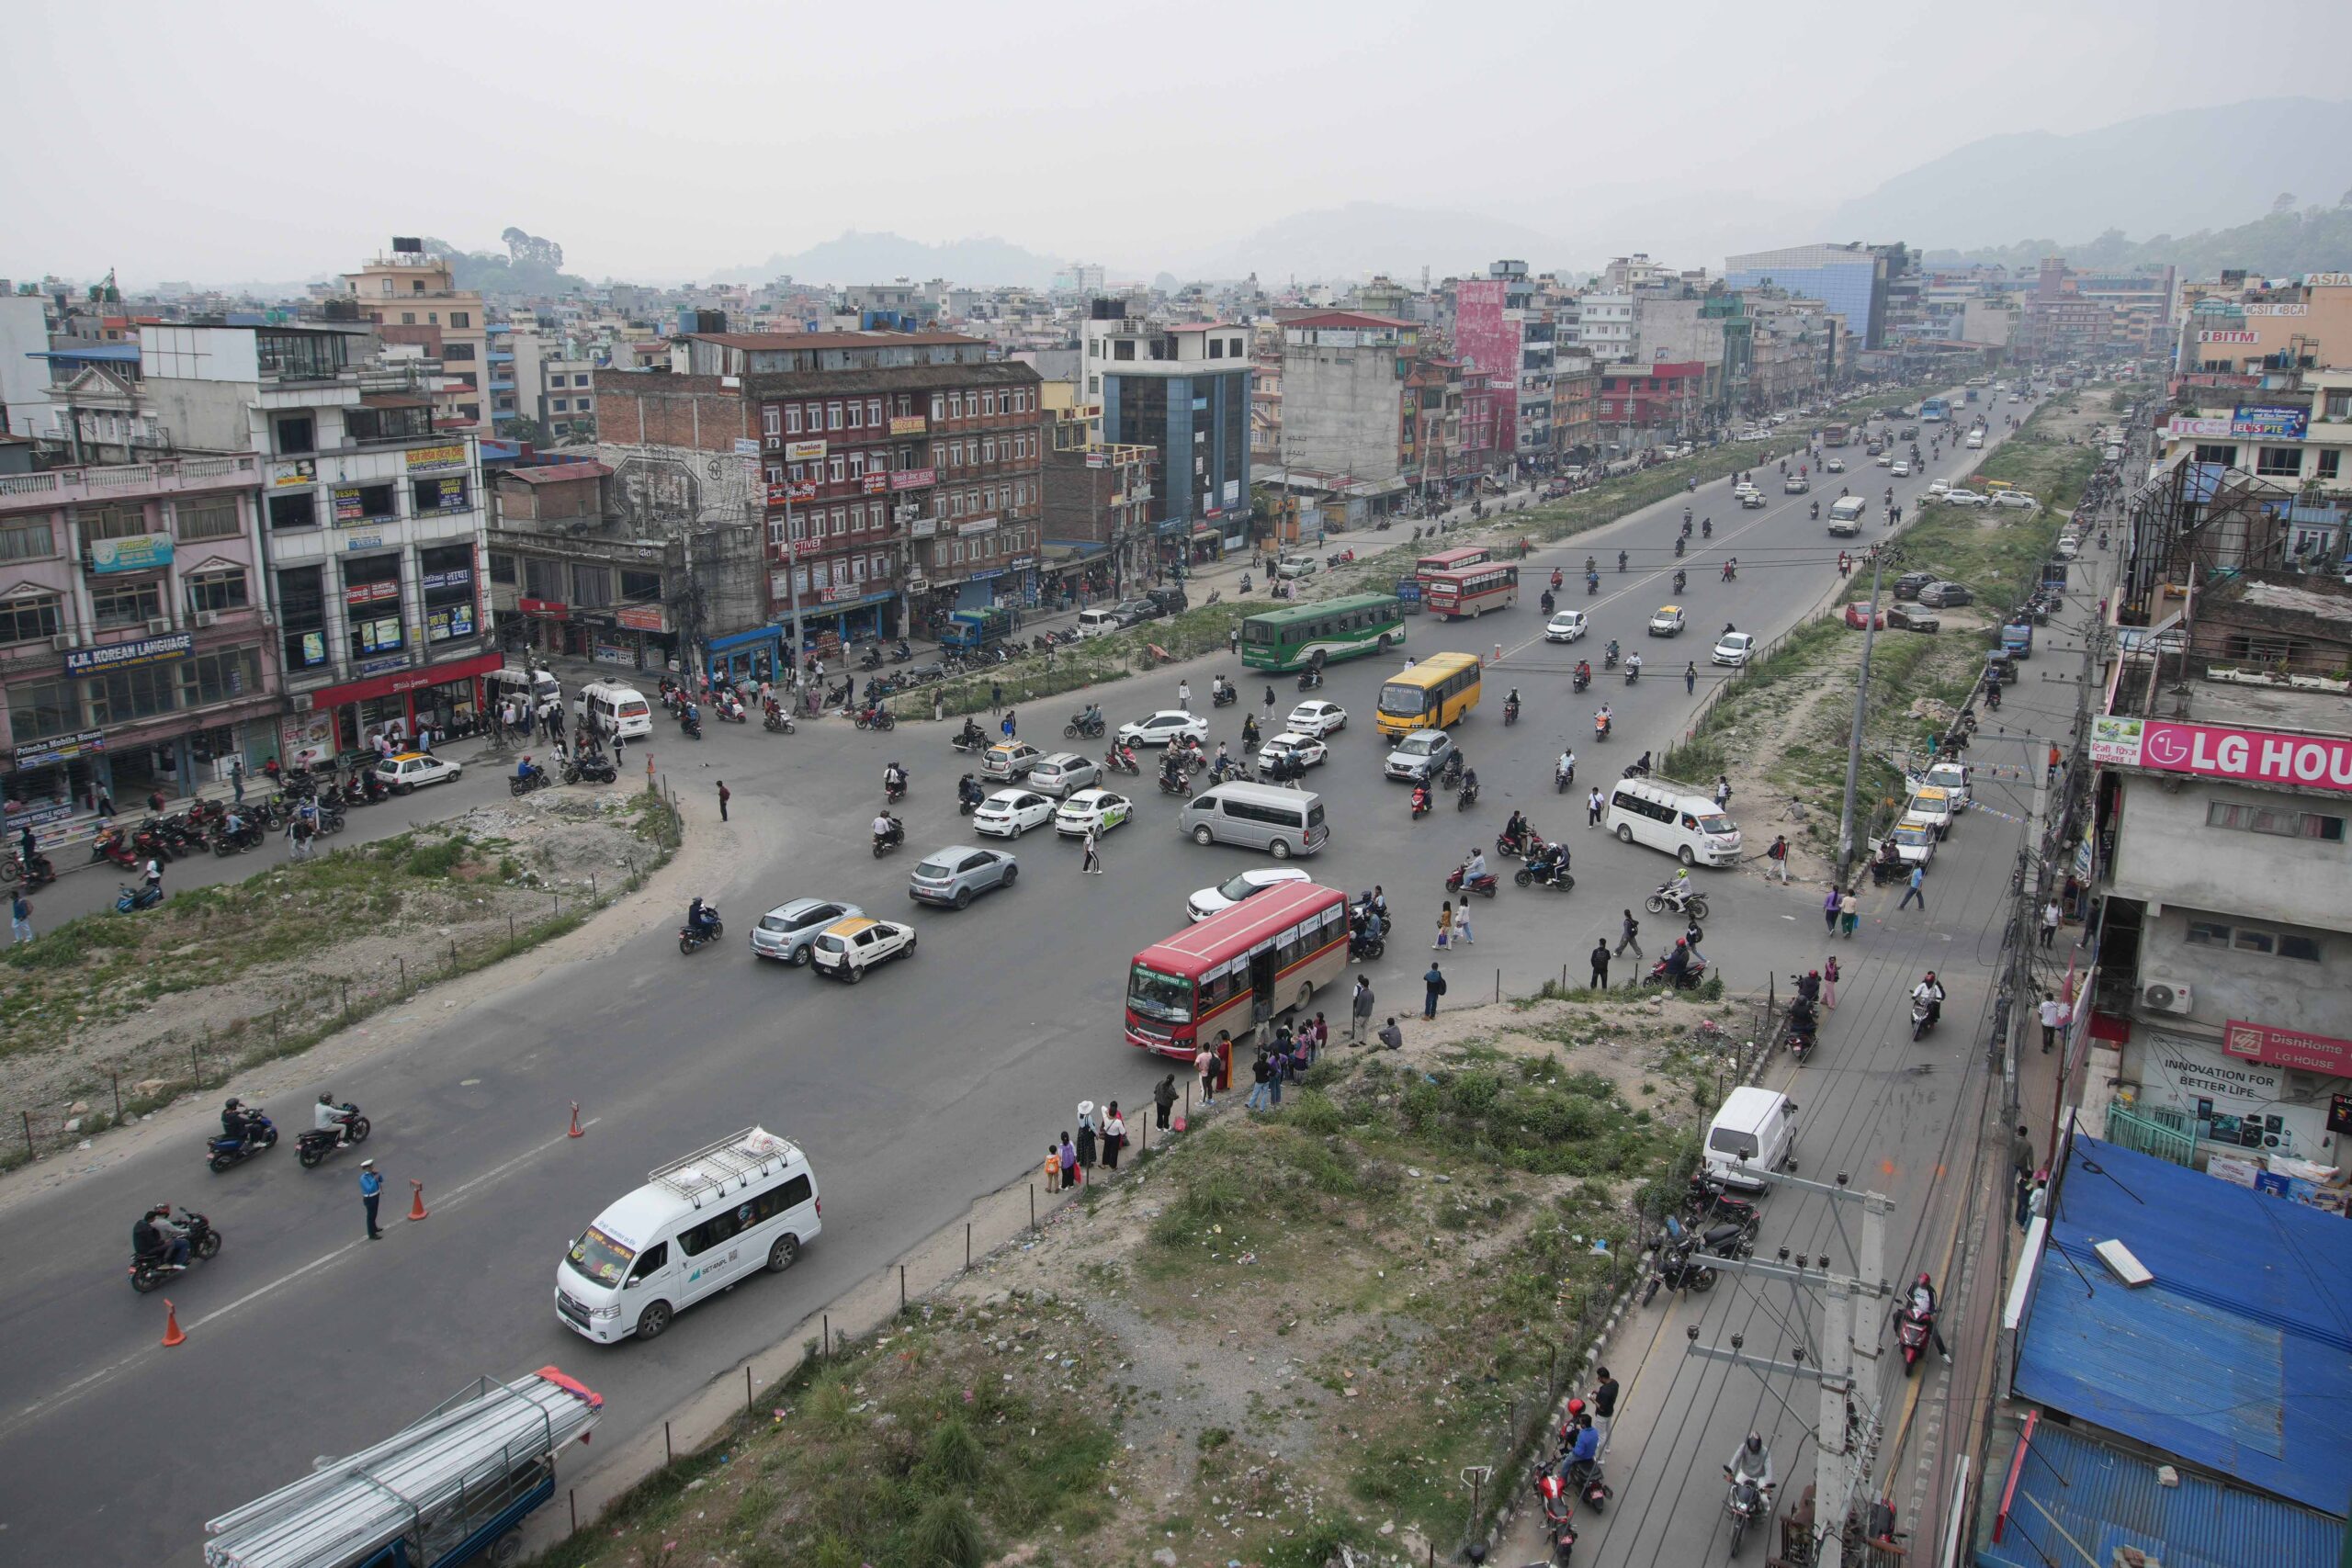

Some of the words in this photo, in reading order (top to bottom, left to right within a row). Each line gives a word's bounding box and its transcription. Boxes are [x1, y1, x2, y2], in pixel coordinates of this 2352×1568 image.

[2308, 274, 2351, 285] ASIA
[2250, 304, 2276, 315] CSIT
[2283, 305, 2305, 315] BCA
[2212, 332, 2255, 343] BITM
[2172, 421, 2205, 434] ITC
[2233, 423, 2261, 433] IELTS
[2264, 424, 2284, 434] PTE
[797, 443, 821, 451] Passion
[335, 489, 360, 498] VESPA
[788, 538, 820, 552] CTIVE!
[447, 569, 469, 581] भाषा
[583, 617, 605, 626] SAMSUNG
[68, 652, 91, 668] K.M.
[93, 644, 136, 663] KOREAN
[137, 635, 191, 656] LANGUAGE
[17, 743, 48, 755] Prinsha
[49, 736, 75, 749] Mobile
[77, 731, 102, 741] House
[2191, 732, 2249, 773] LG
[2259, 739, 2352, 784] HOU
[6, 816, 31, 827] PRINSHA
[31, 811, 52, 821] MOBILE
[53, 807, 73, 817] HOUSE
[2271, 1033, 2343, 1055] DishHome
[2276, 1052, 2291, 1062] LG
[2294, 1055, 2335, 1070] HOUSE
[2165, 1059, 2246, 1082] INNOVATION
[2249, 1074, 2275, 1087] FOR
[2179, 1076, 2226, 1092] BETTER
[2229, 1085, 2255, 1098] LIFE
